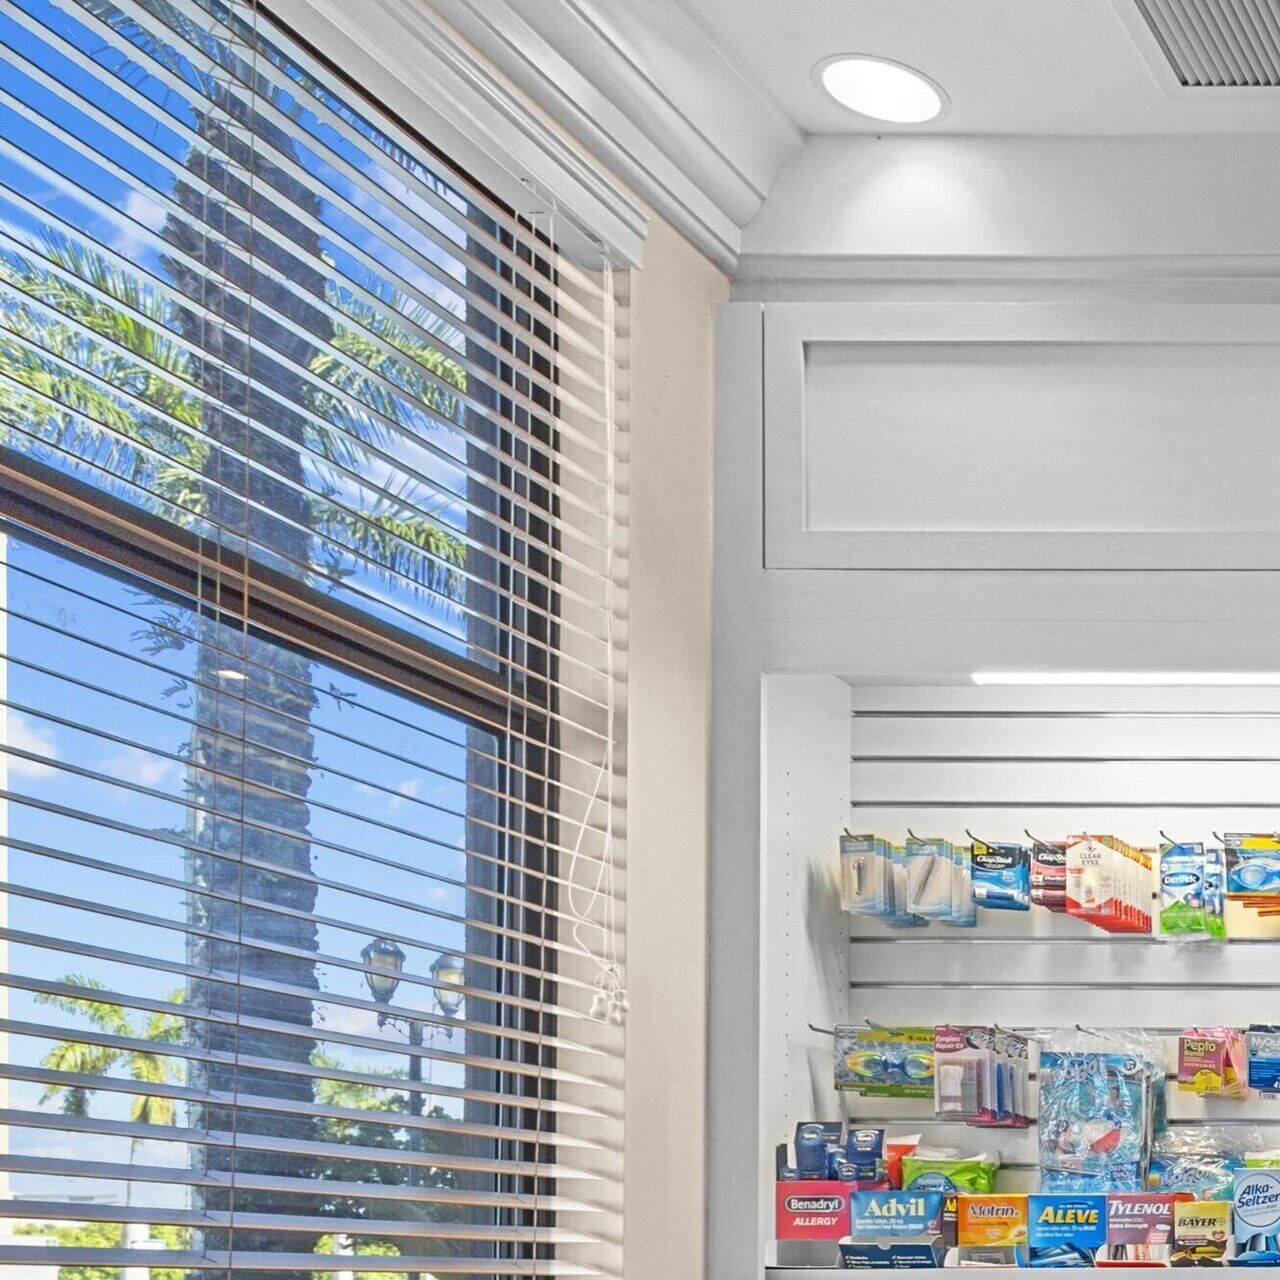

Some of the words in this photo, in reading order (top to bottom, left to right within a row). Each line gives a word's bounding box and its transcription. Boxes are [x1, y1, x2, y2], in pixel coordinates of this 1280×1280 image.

[1184, 1040, 1216, 1053] Pepto
[1240, 1184, 1274, 1197] Alka-
[791, 1199, 839, 1213] Benadryl
[864, 1198, 927, 1216] Advil
[968, 1204, 1015, 1217] Motrin
[1109, 1200, 1171, 1215] TYLENOL
[1038, 1206, 1098, 1223] ALEVE
[793, 1217, 838, 1226] ALLERGY
[1178, 1218, 1217, 1227] BAYER
